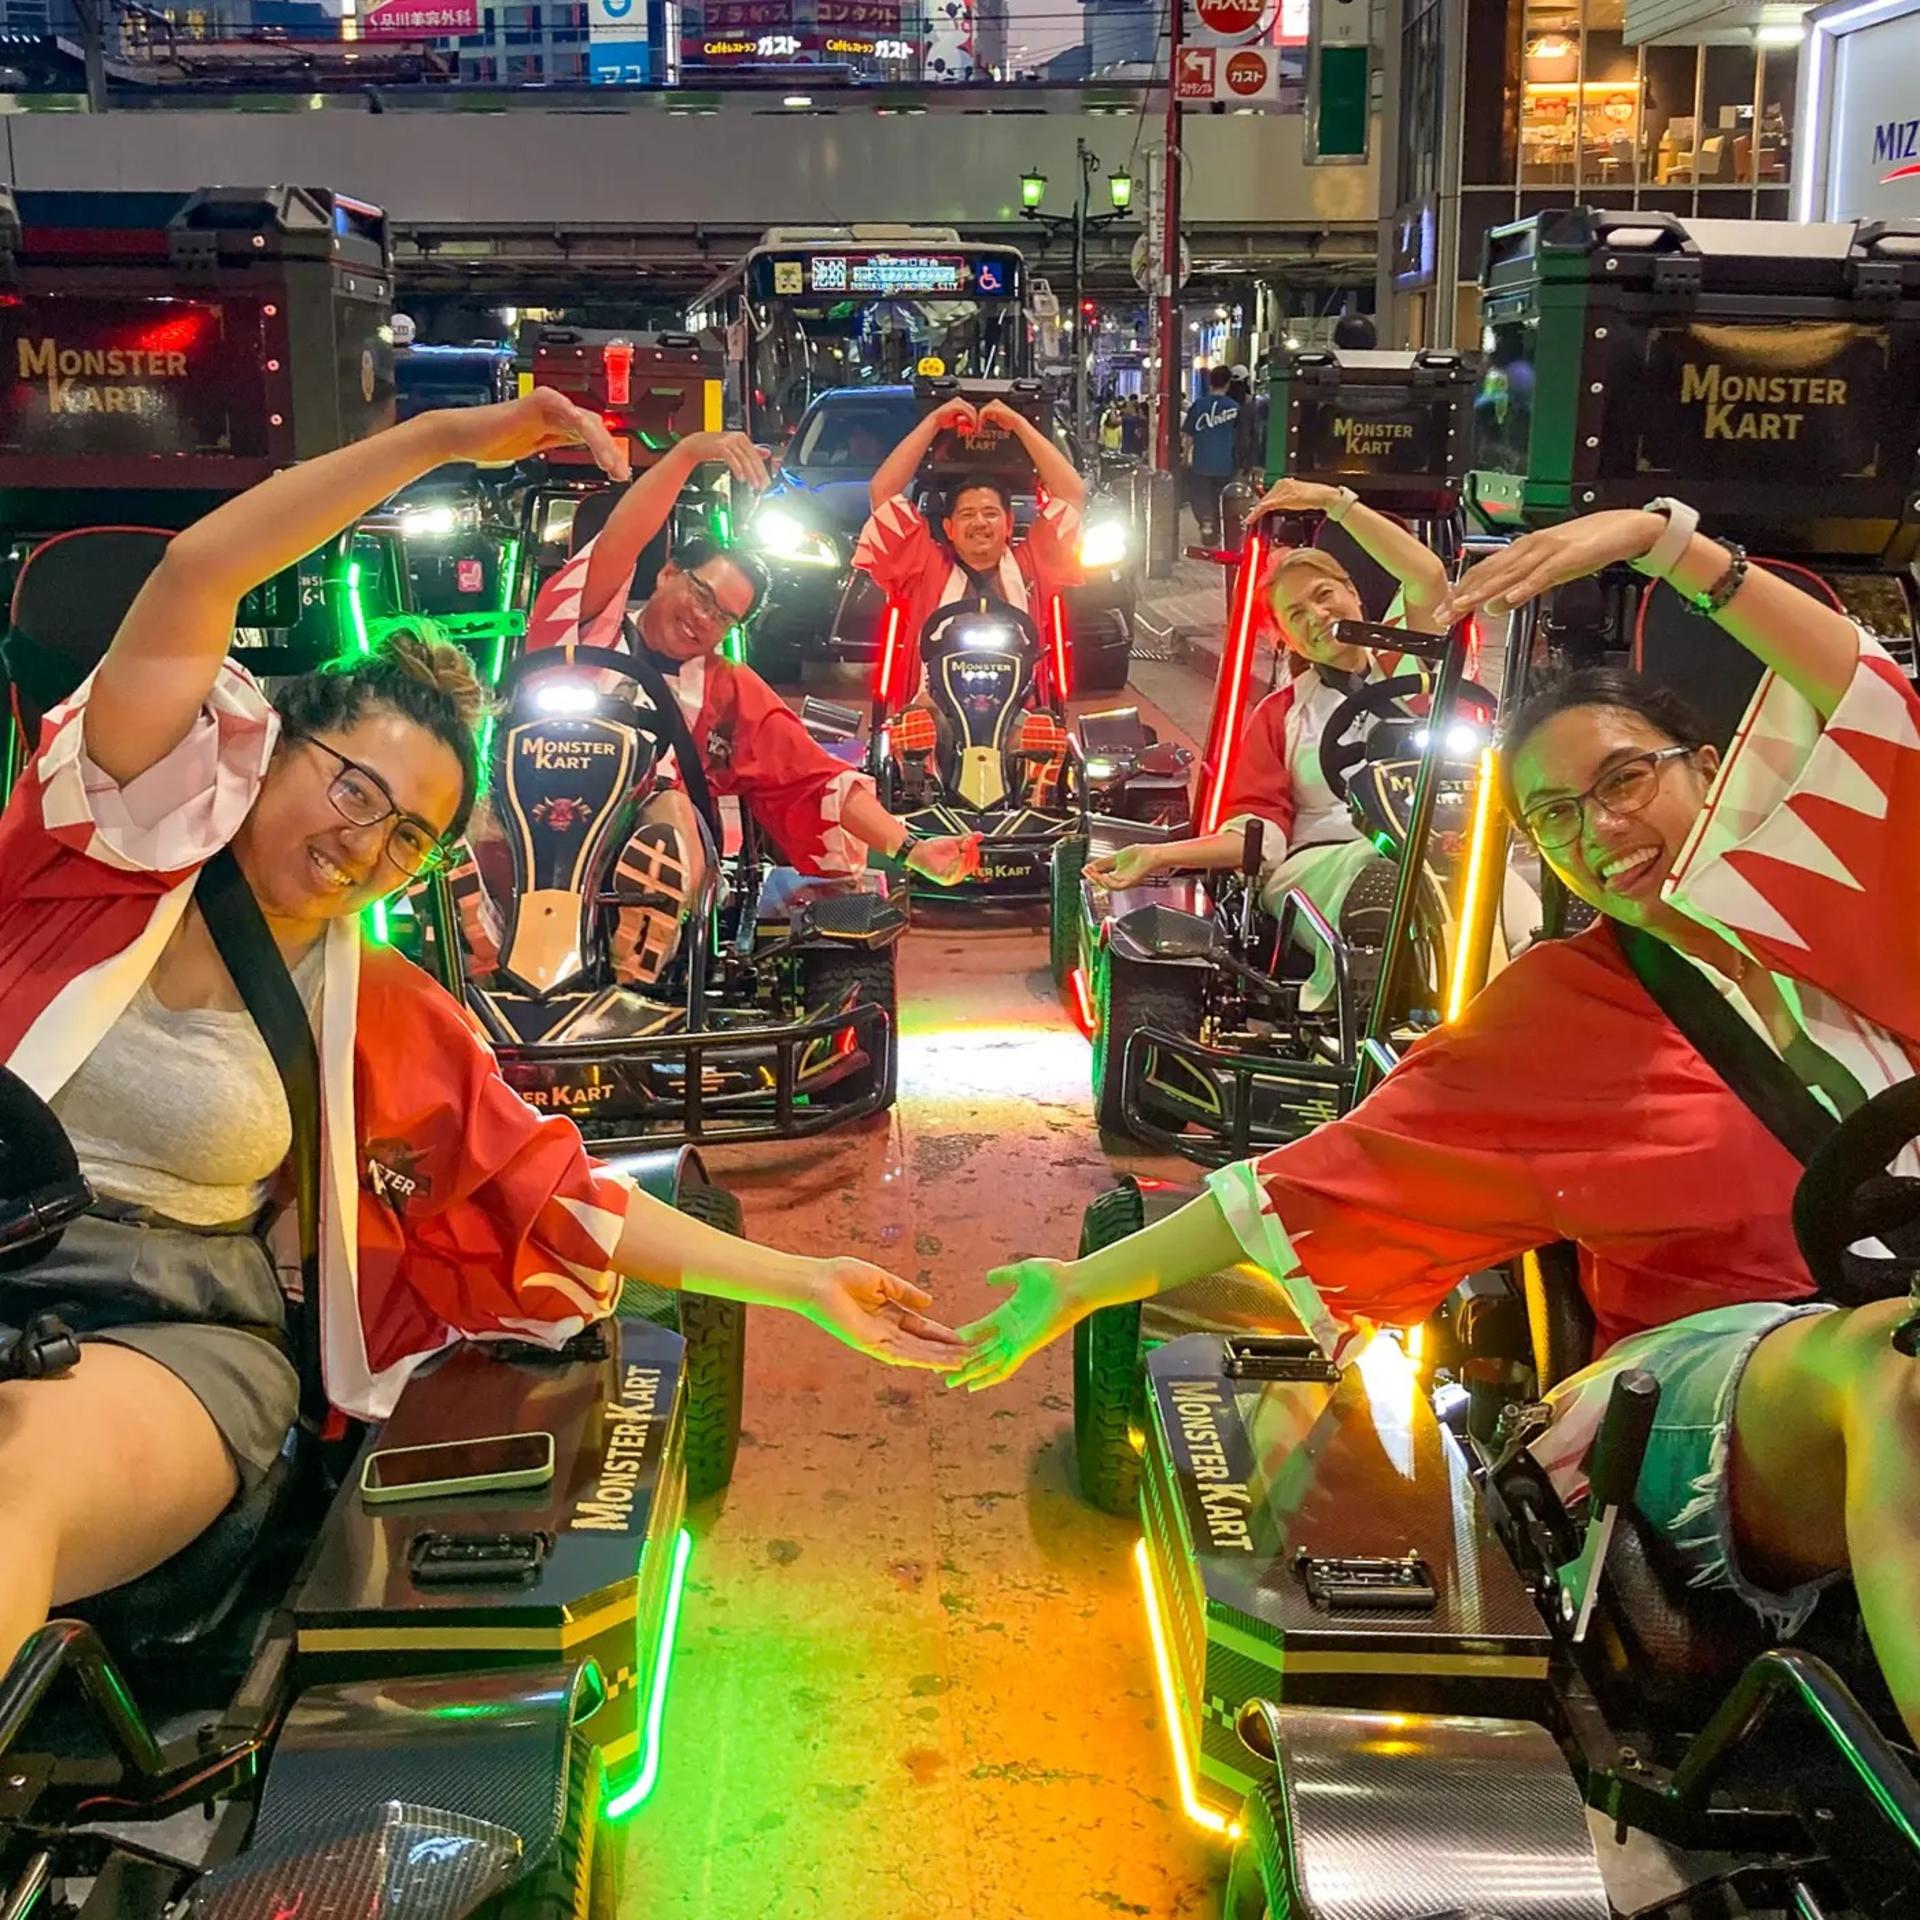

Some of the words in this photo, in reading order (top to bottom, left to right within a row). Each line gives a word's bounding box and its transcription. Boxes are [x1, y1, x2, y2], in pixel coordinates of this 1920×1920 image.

[1230, 71, 1264, 83] ガスト
[16, 338, 188, 378] MONSTER
[1680, 363, 1848, 405] MONSTER
[48, 377, 145, 414] KART
[1334, 417, 1413, 440] MONSTER
[1704, 404, 1805, 440] KART
[1345, 436, 1393, 455] KART
[951, 661, 1012, 673] MONSTER
[521, 737, 616, 756] MONSTER
[535, 752, 592, 769] KART
[995, 865, 1032, 878] KART
[552, 1085, 616, 1106] KART
